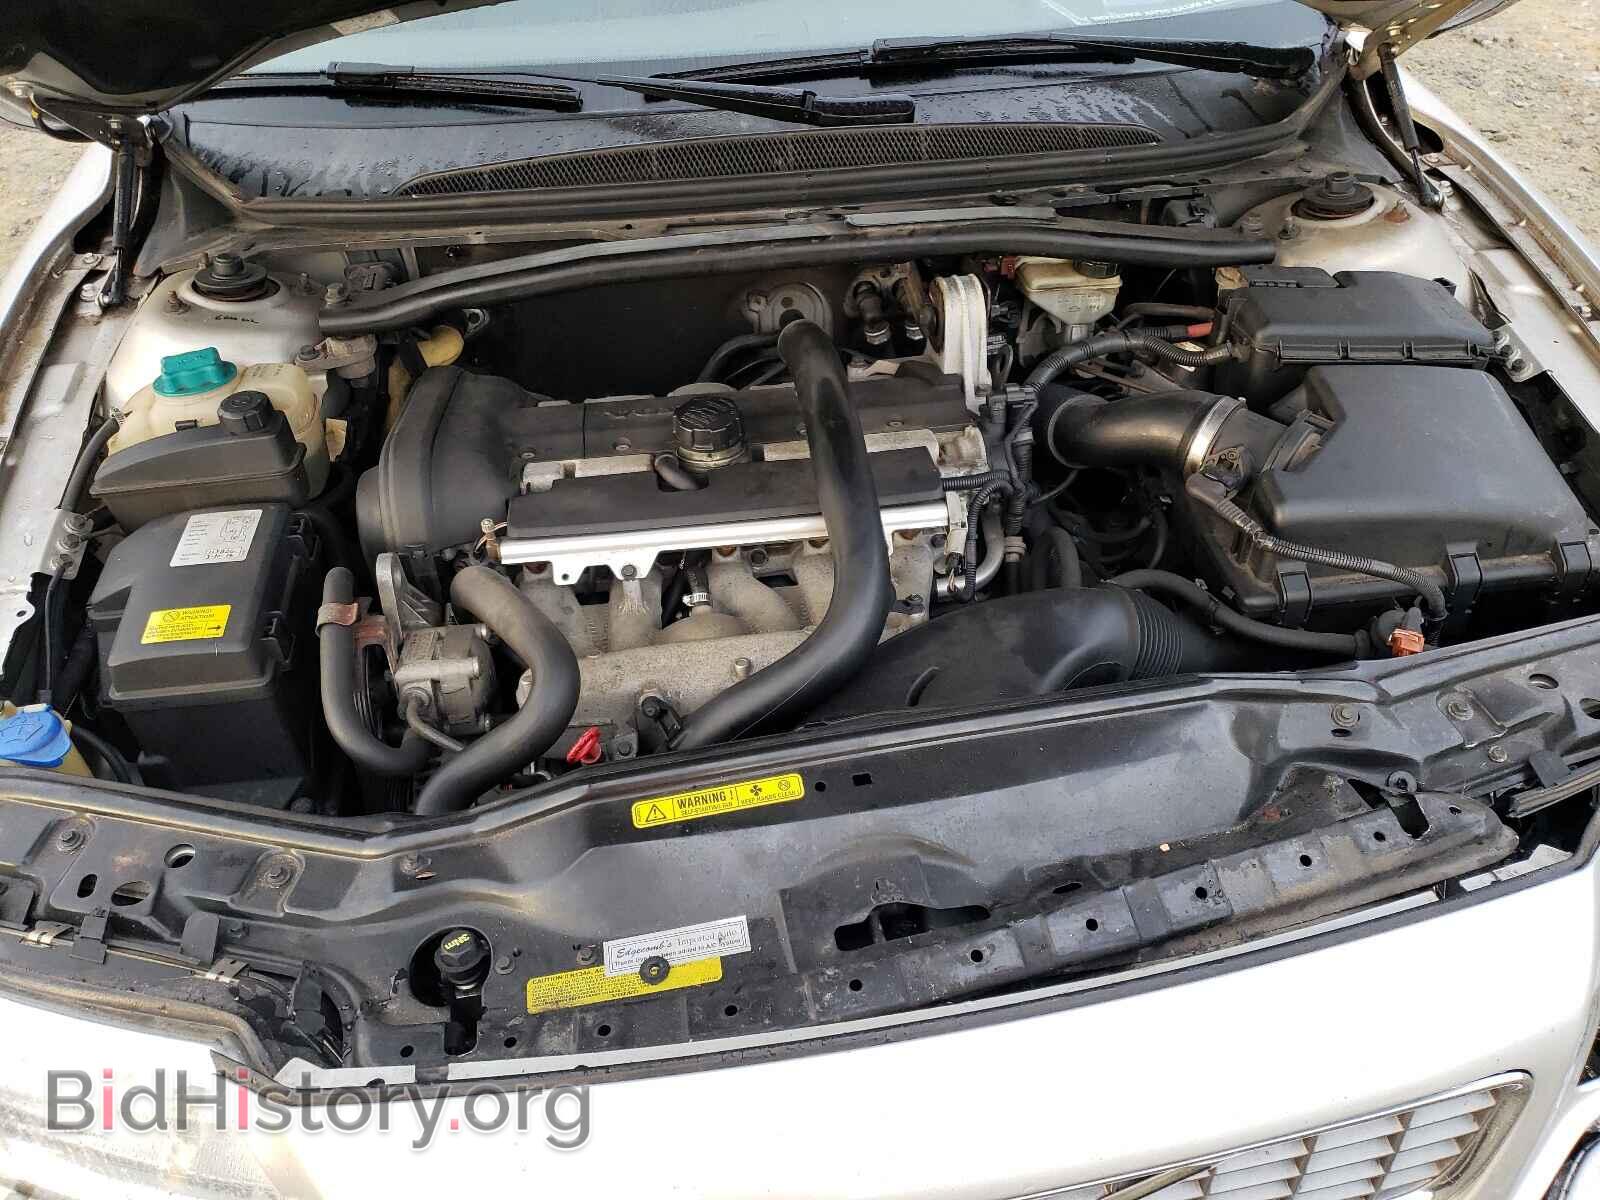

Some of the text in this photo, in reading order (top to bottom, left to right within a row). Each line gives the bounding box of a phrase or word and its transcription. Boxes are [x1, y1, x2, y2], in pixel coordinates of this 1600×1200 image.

[677, 791, 726, 809] WARNING
[617, 939, 673, 959] Edgecomb's
[677, 931, 716, 947] Imported
[533, 975, 562, 985] CAUTION
